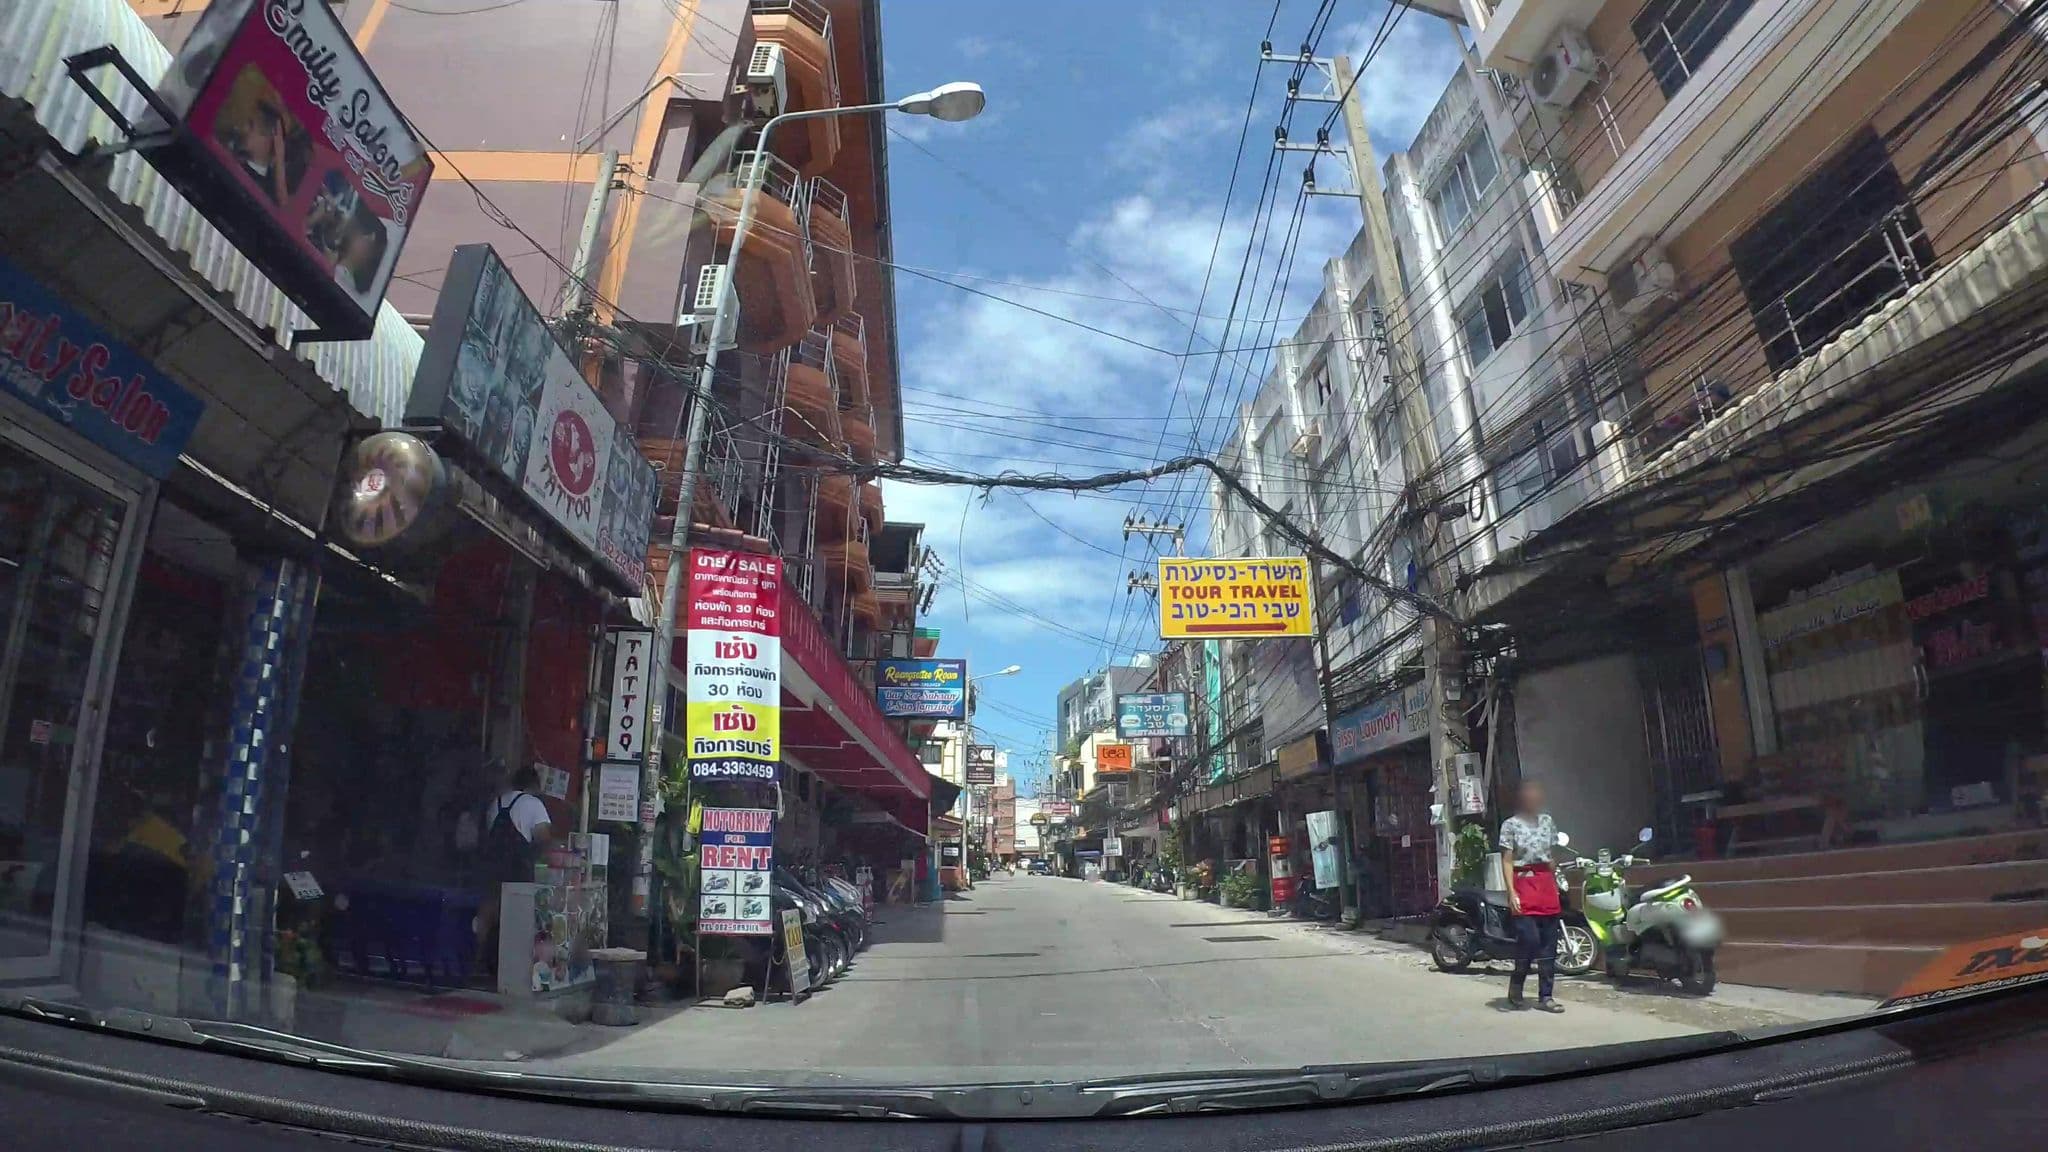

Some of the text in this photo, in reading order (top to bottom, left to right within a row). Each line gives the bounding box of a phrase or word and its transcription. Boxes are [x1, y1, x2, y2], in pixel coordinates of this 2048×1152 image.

[264, 0, 341, 108] Emily
[338, 87, 402, 183] Salon
[67, 343, 171, 446] Salon
[739, 560, 776, 575] SALE
[1168, 585, 1302, 599] TOUR TRAVEL
[735, 604, 752, 614] 30
[755, 604, 775, 618] ห้อง
[714, 635, 758, 660] เซ้ง
[694, 662, 777, 682] กิจการห้องพัก
[618, 638, 643, 753] TATTOO
[708, 681, 763, 699] 30 ห้อง
[713, 704, 757, 732] เซ้ง
[1360, 708, 1401, 740] Laundry
[694, 737, 772, 757] กิจการบาร์
[1102, 746, 1126, 760] tea
[692, 762, 774, 779] 084-3363459
[703, 809, 772, 832] MOTORBIKE
[724, 834, 746, 844] FOR
[701, 844, 772, 870] RENT
